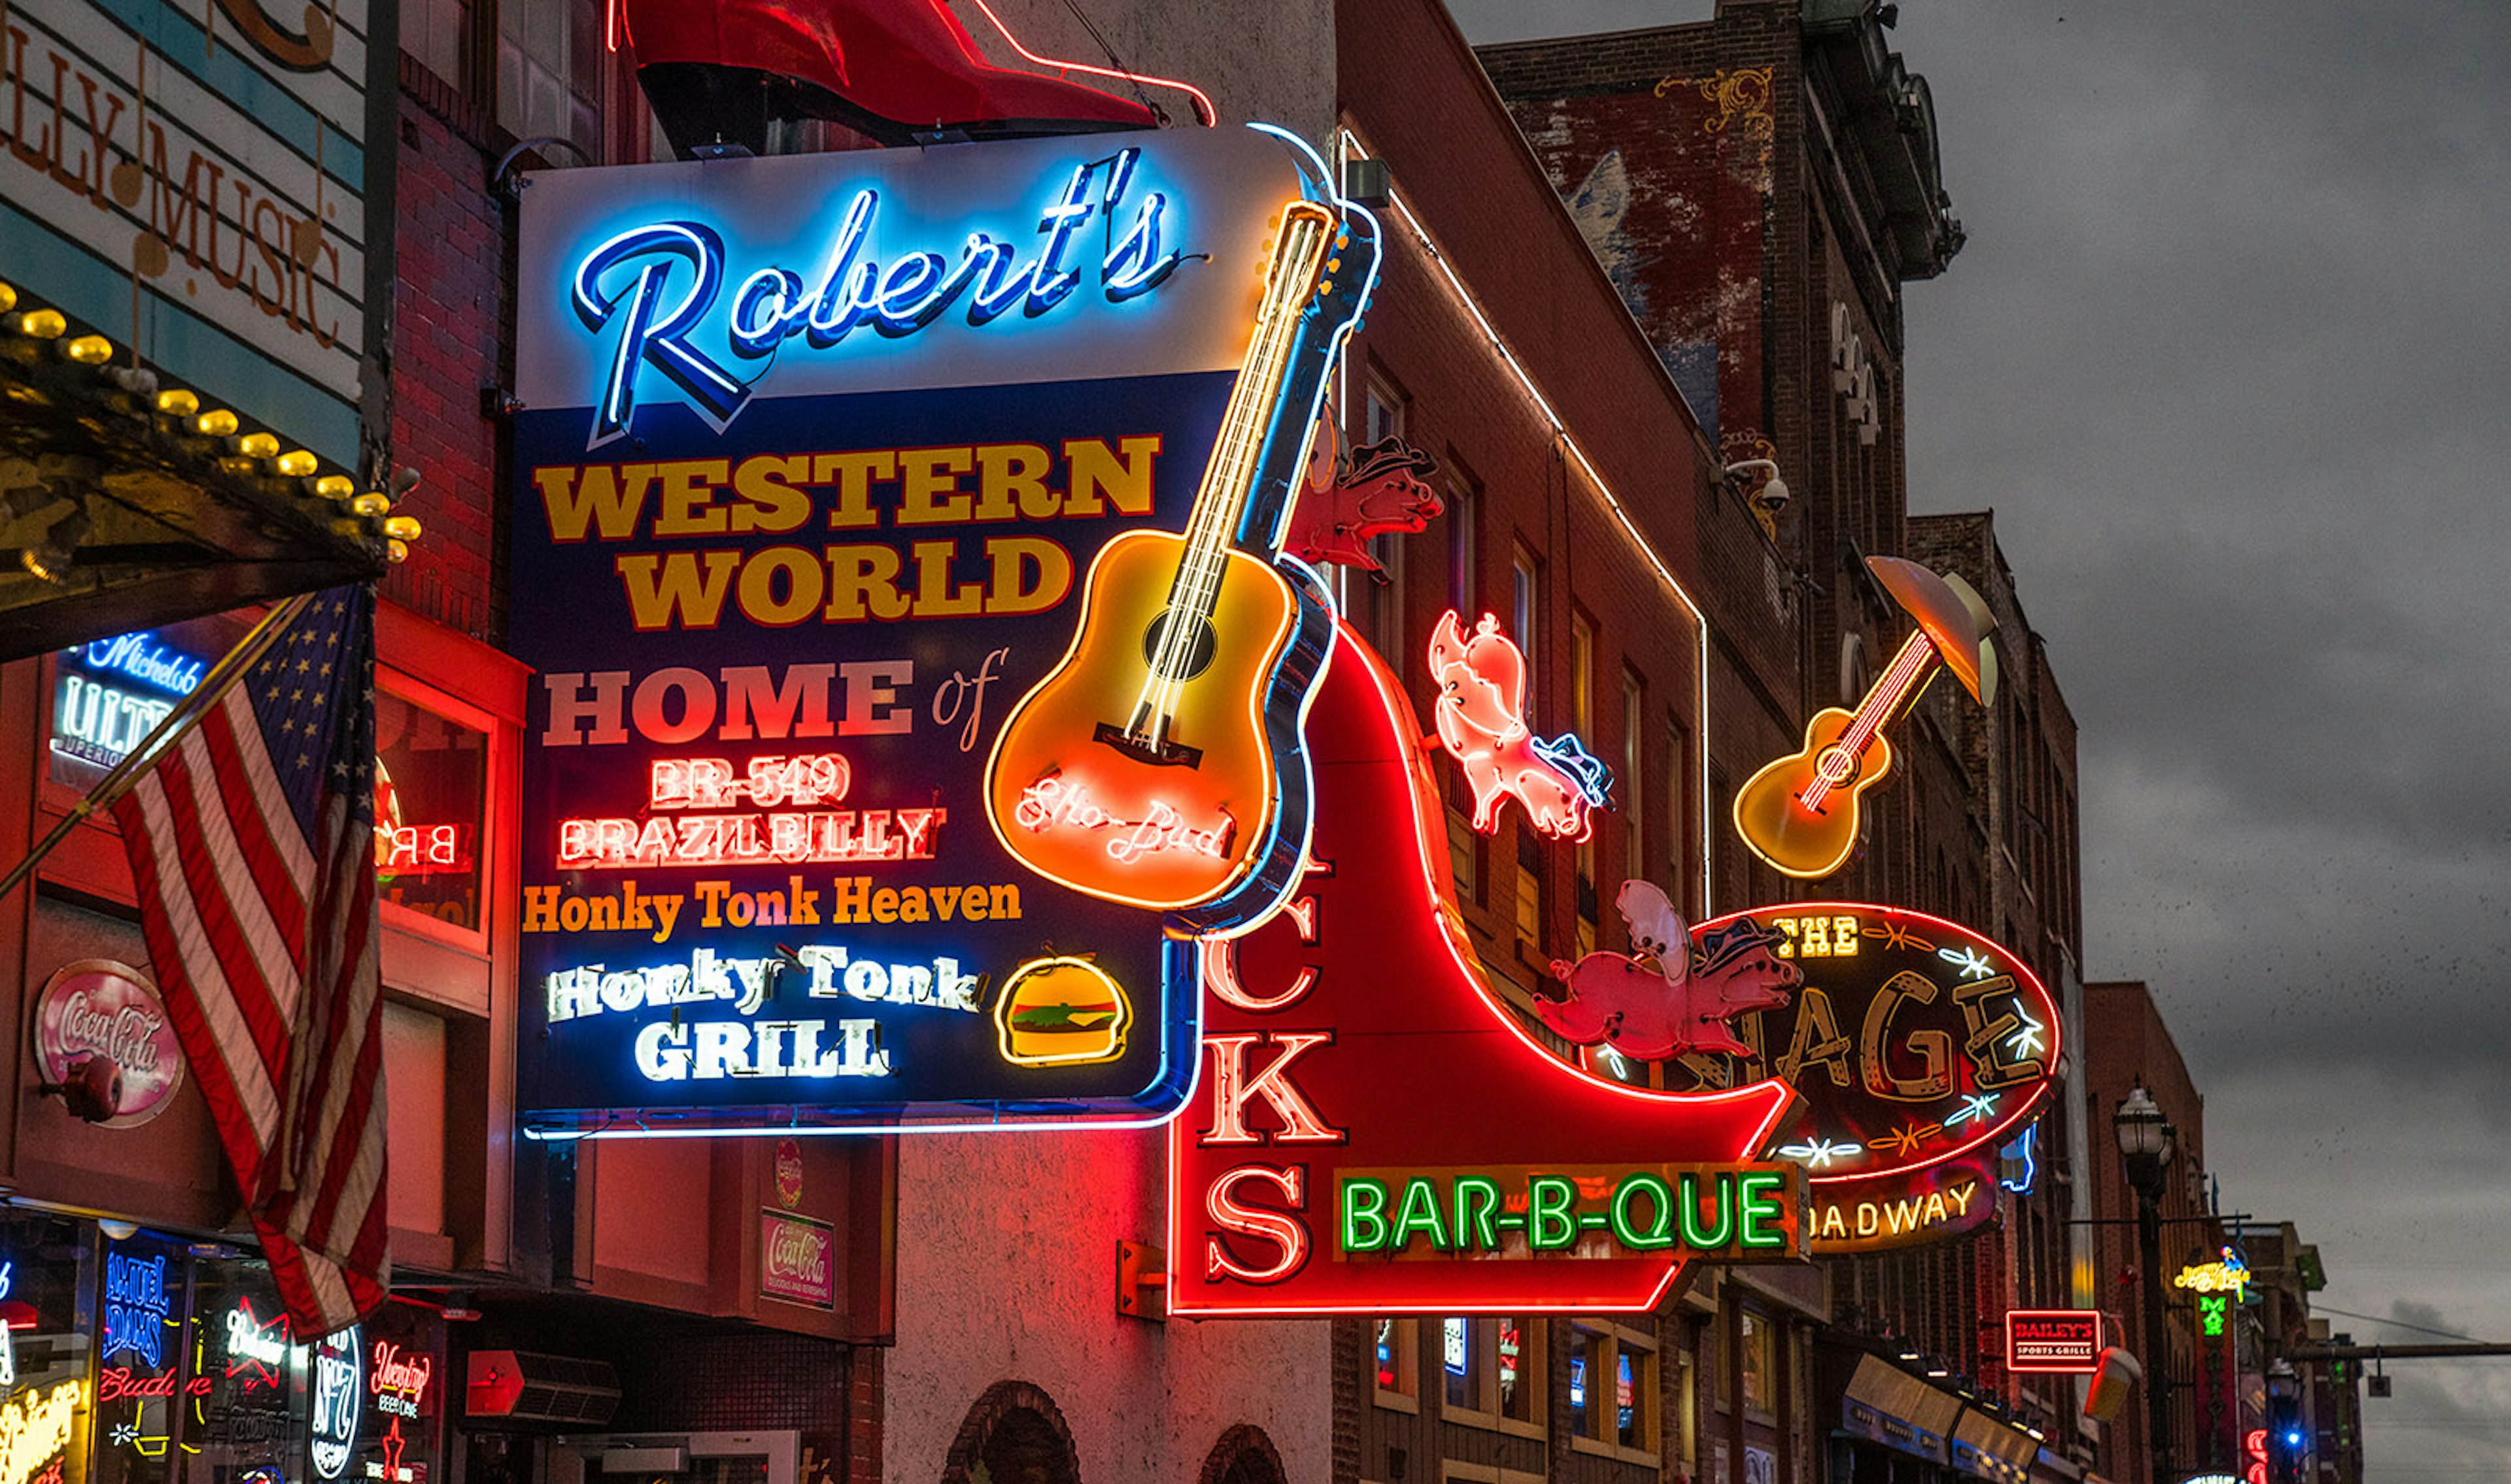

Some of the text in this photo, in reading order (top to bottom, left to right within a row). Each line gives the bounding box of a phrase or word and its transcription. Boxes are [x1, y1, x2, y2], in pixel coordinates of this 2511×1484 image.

[0, 26, 340, 350] LLY MUSIC
[572, 148, 1181, 451] Robert's
[533, 434, 1163, 543] WESTERN
[615, 535, 1074, 632] WORLD
[88, 633, 201, 694] Michelob
[542, 659, 914, 746] HOME
[931, 647, 1009, 751] of
[651, 752, 851, 809] BR-549
[523, 881, 684, 943] Honky
[694, 875, 820, 928] Tonk
[834, 876, 1022, 924] Heaven
[1772, 917, 1859, 958] THE
[545, 945, 981, 1022] Honky Tonk
[634, 1019, 891, 1081] GRILL
[1677, 970, 2045, 1102] AGE
[1341, 1171, 1787, 1251] BAR-B-QUE
[2014, 1323, 2092, 1339] BAILEY'S
[2017, 1347, 2092, 1355] SPORTS GRILLE
